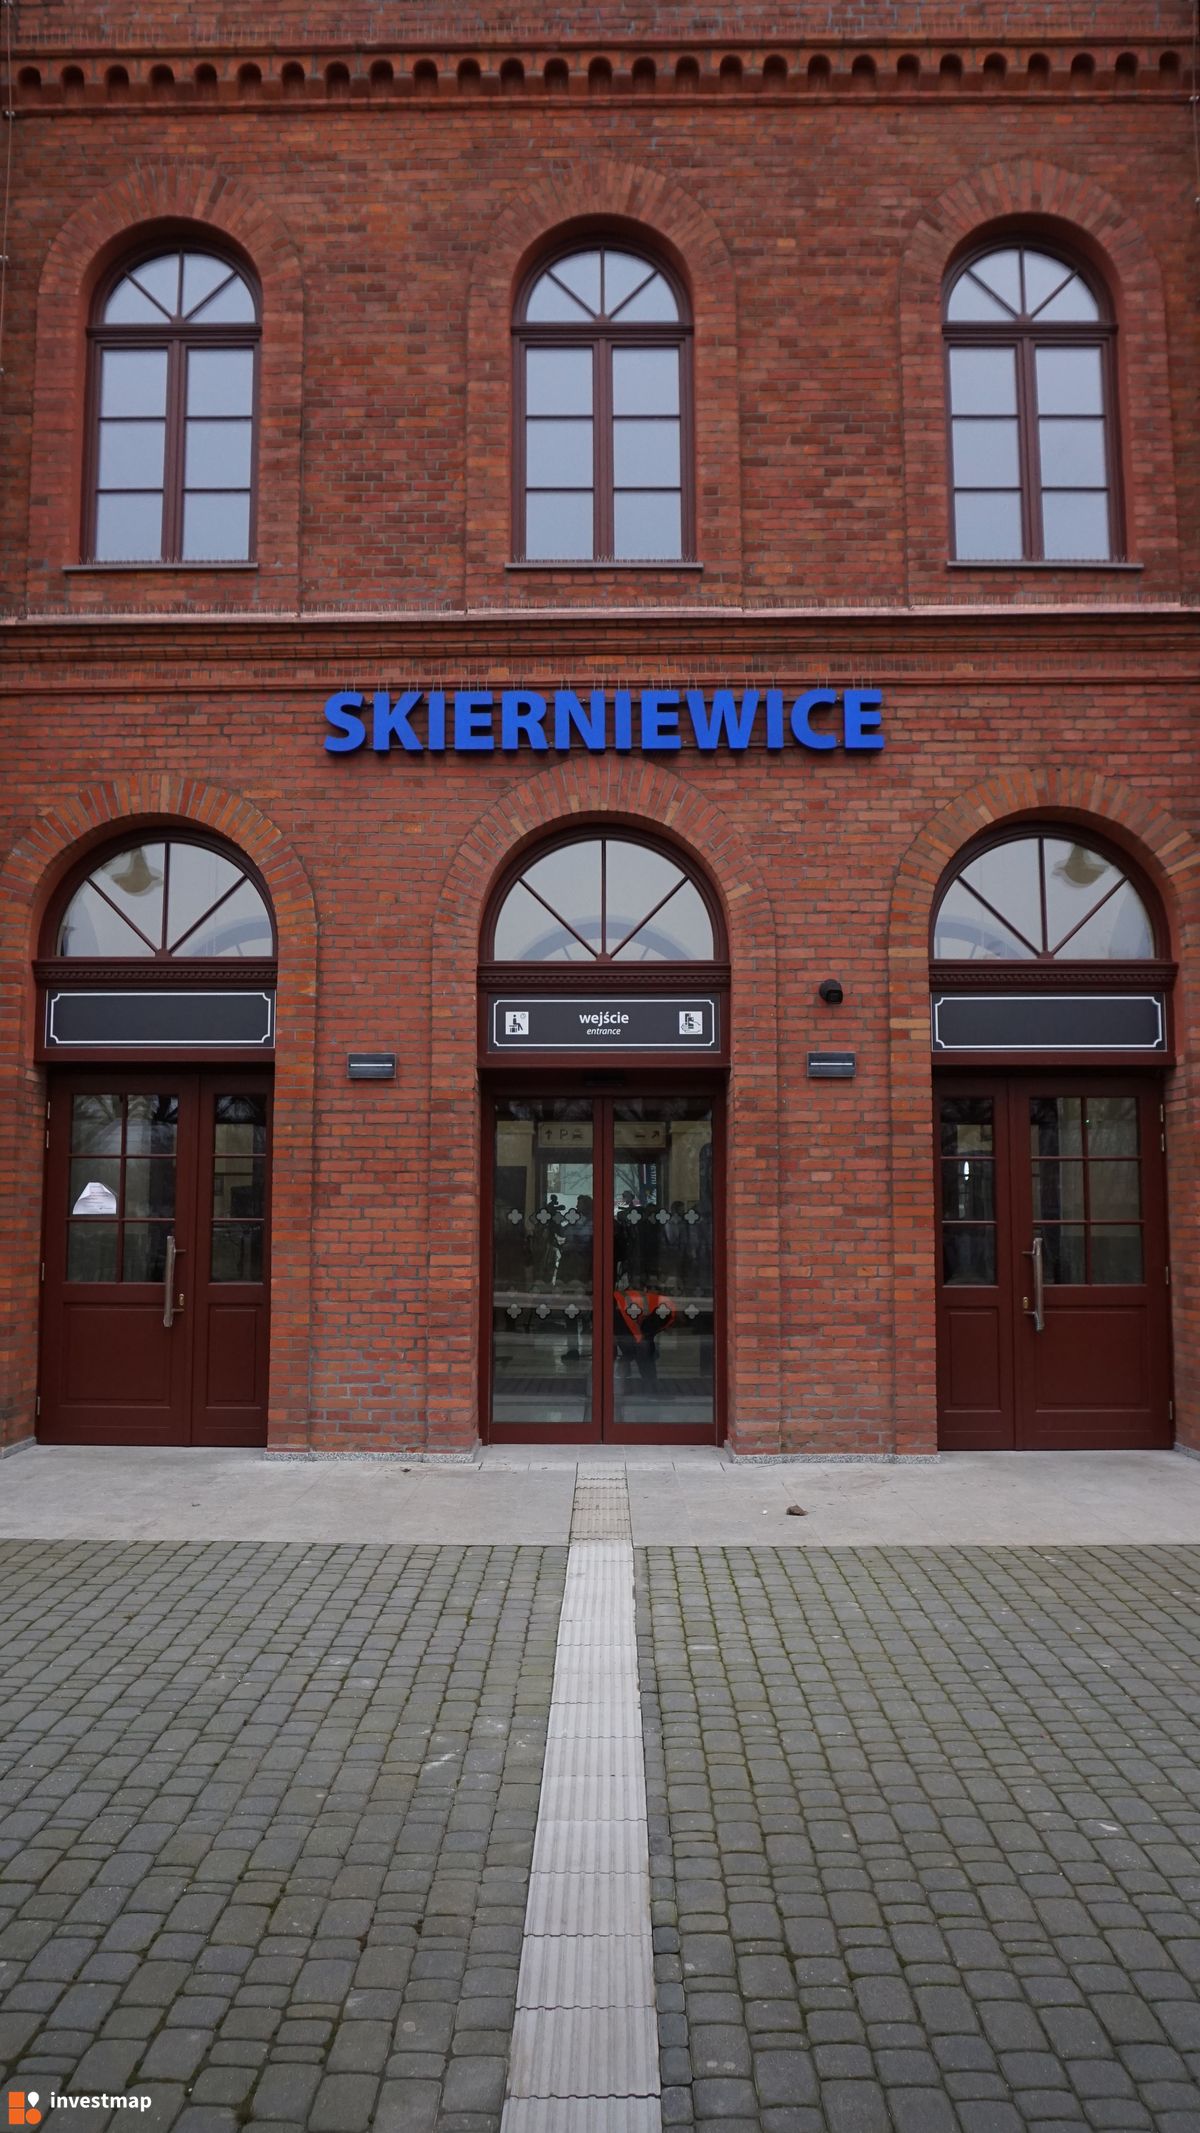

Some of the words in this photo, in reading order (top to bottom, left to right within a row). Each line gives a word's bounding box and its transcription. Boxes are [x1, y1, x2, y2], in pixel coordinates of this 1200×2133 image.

[324, 688, 885, 753] SKIERNIEWICE
[579, 1011, 630, 1027] wejście
[586, 1027, 622, 1036] entrance
